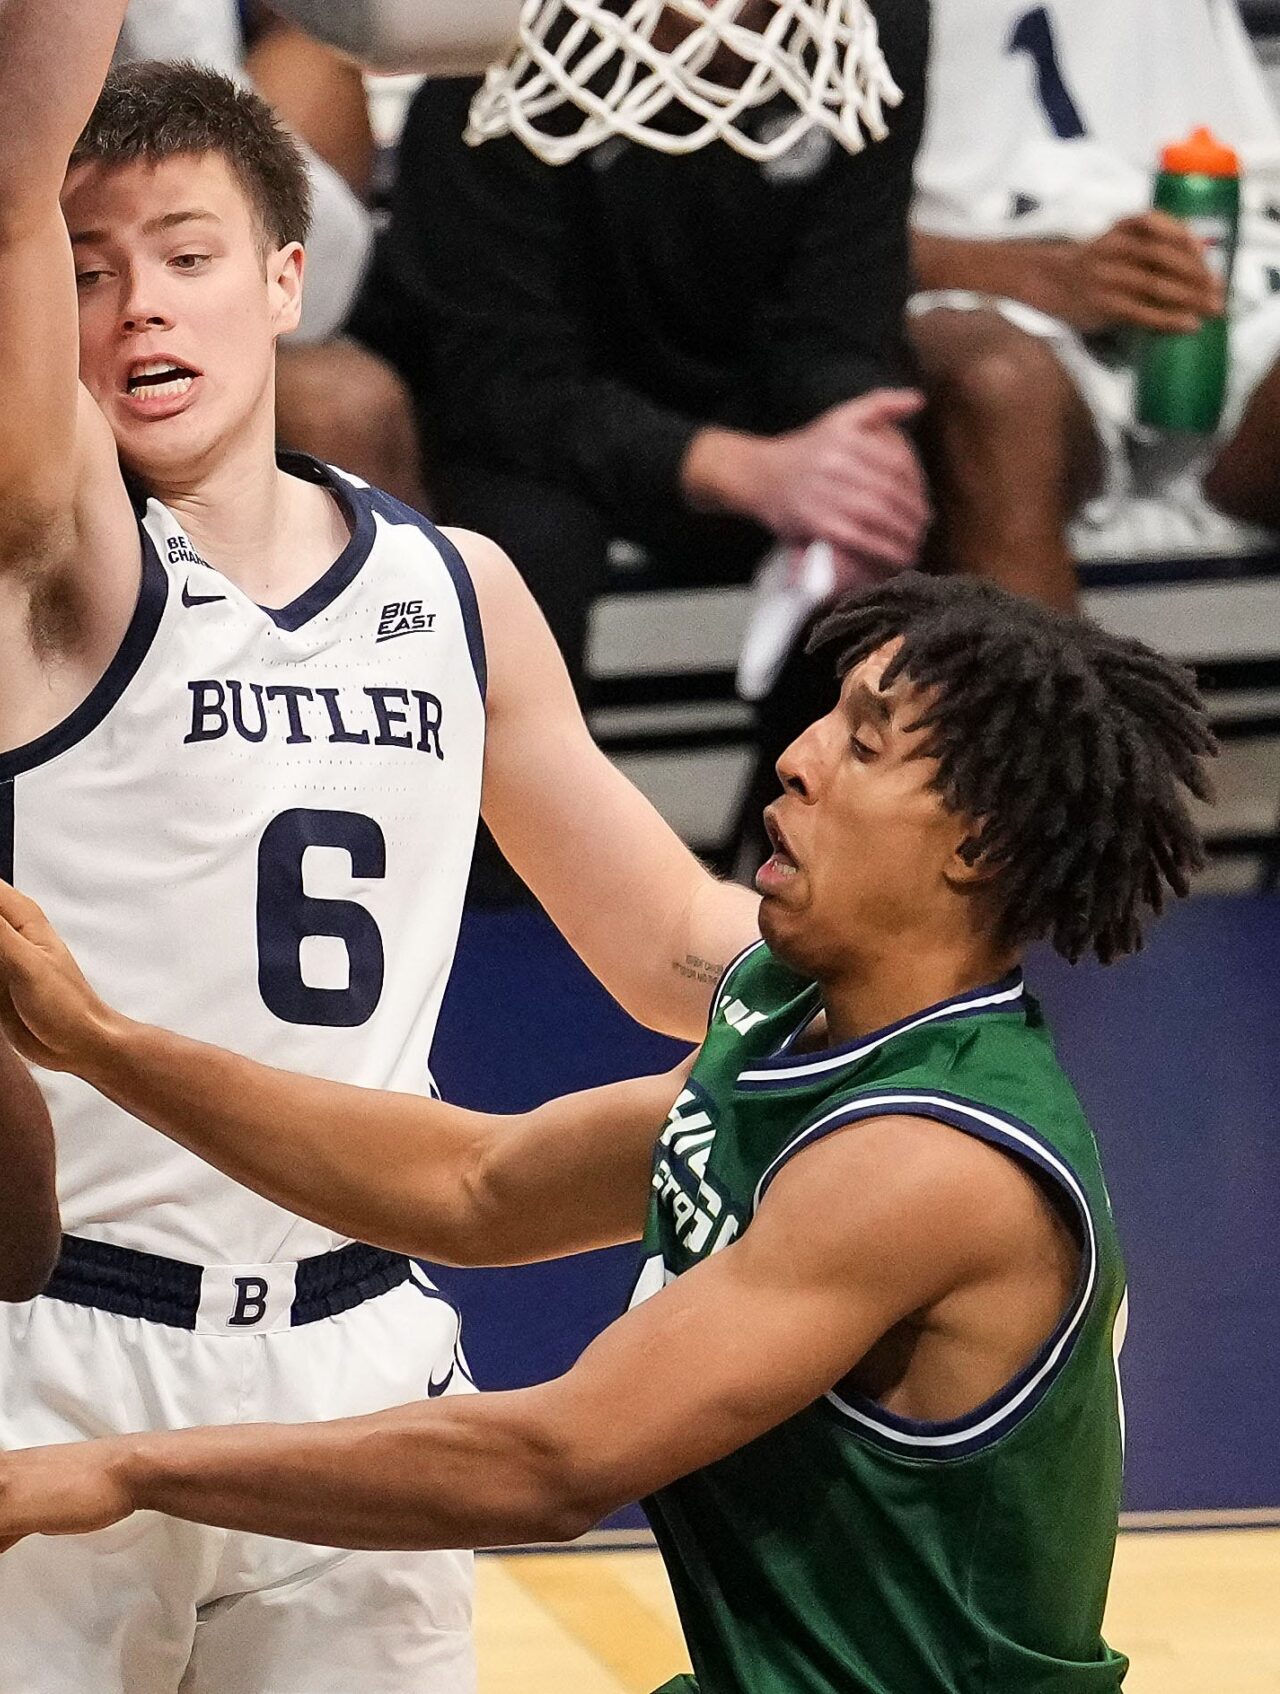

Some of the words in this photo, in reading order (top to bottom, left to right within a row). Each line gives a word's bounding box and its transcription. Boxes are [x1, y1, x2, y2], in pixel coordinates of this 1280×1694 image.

[1008, 7, 1086, 139] 1
[167, 536, 187, 549] BE
[377, 614, 436, 635] EAST
[381, 600, 423, 619] BIG
[183, 680, 444, 760] BUTLER
[257, 808, 386, 1027] 6
[228, 1277, 269, 1327] B
